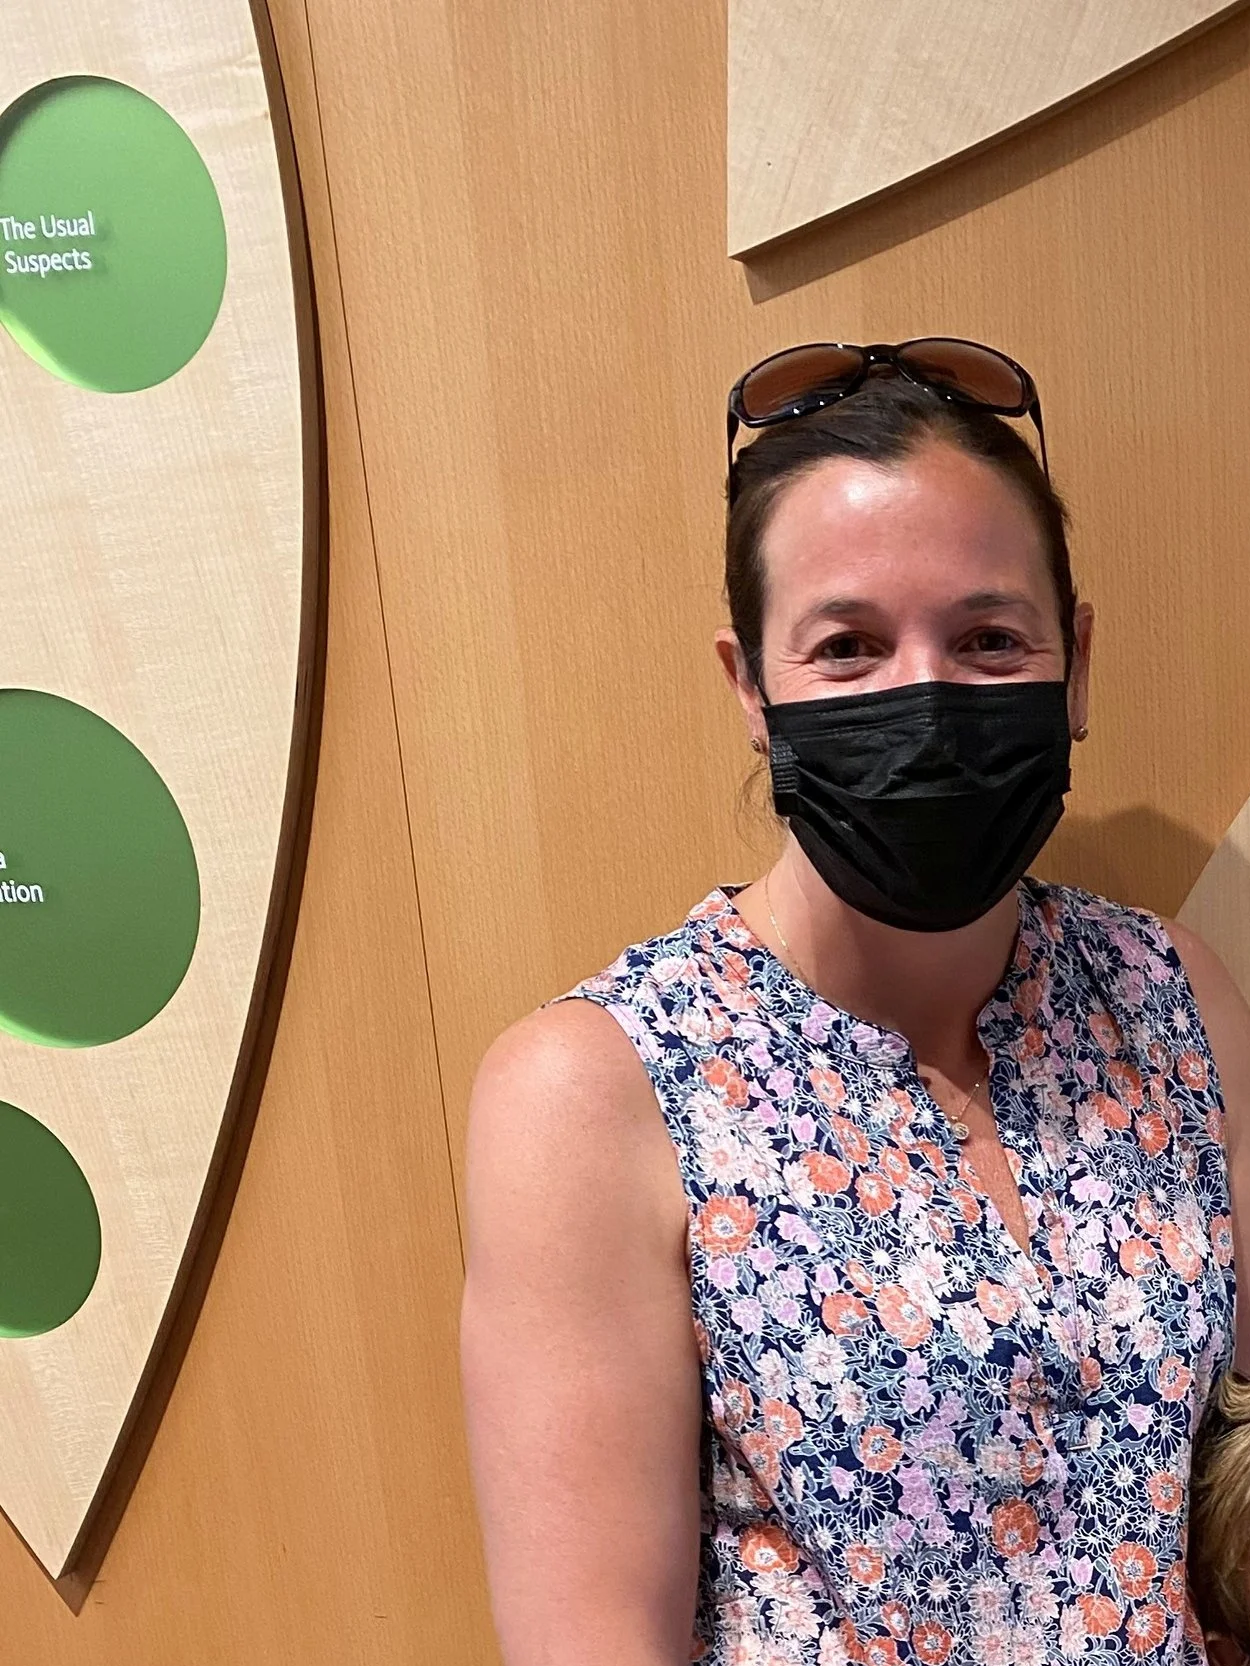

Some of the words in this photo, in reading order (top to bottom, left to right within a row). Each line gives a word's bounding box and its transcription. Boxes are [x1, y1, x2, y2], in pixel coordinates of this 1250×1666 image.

[0, 215, 37, 241] The
[39, 209, 97, 239] Usual
[4, 247, 94, 279] Suspects
